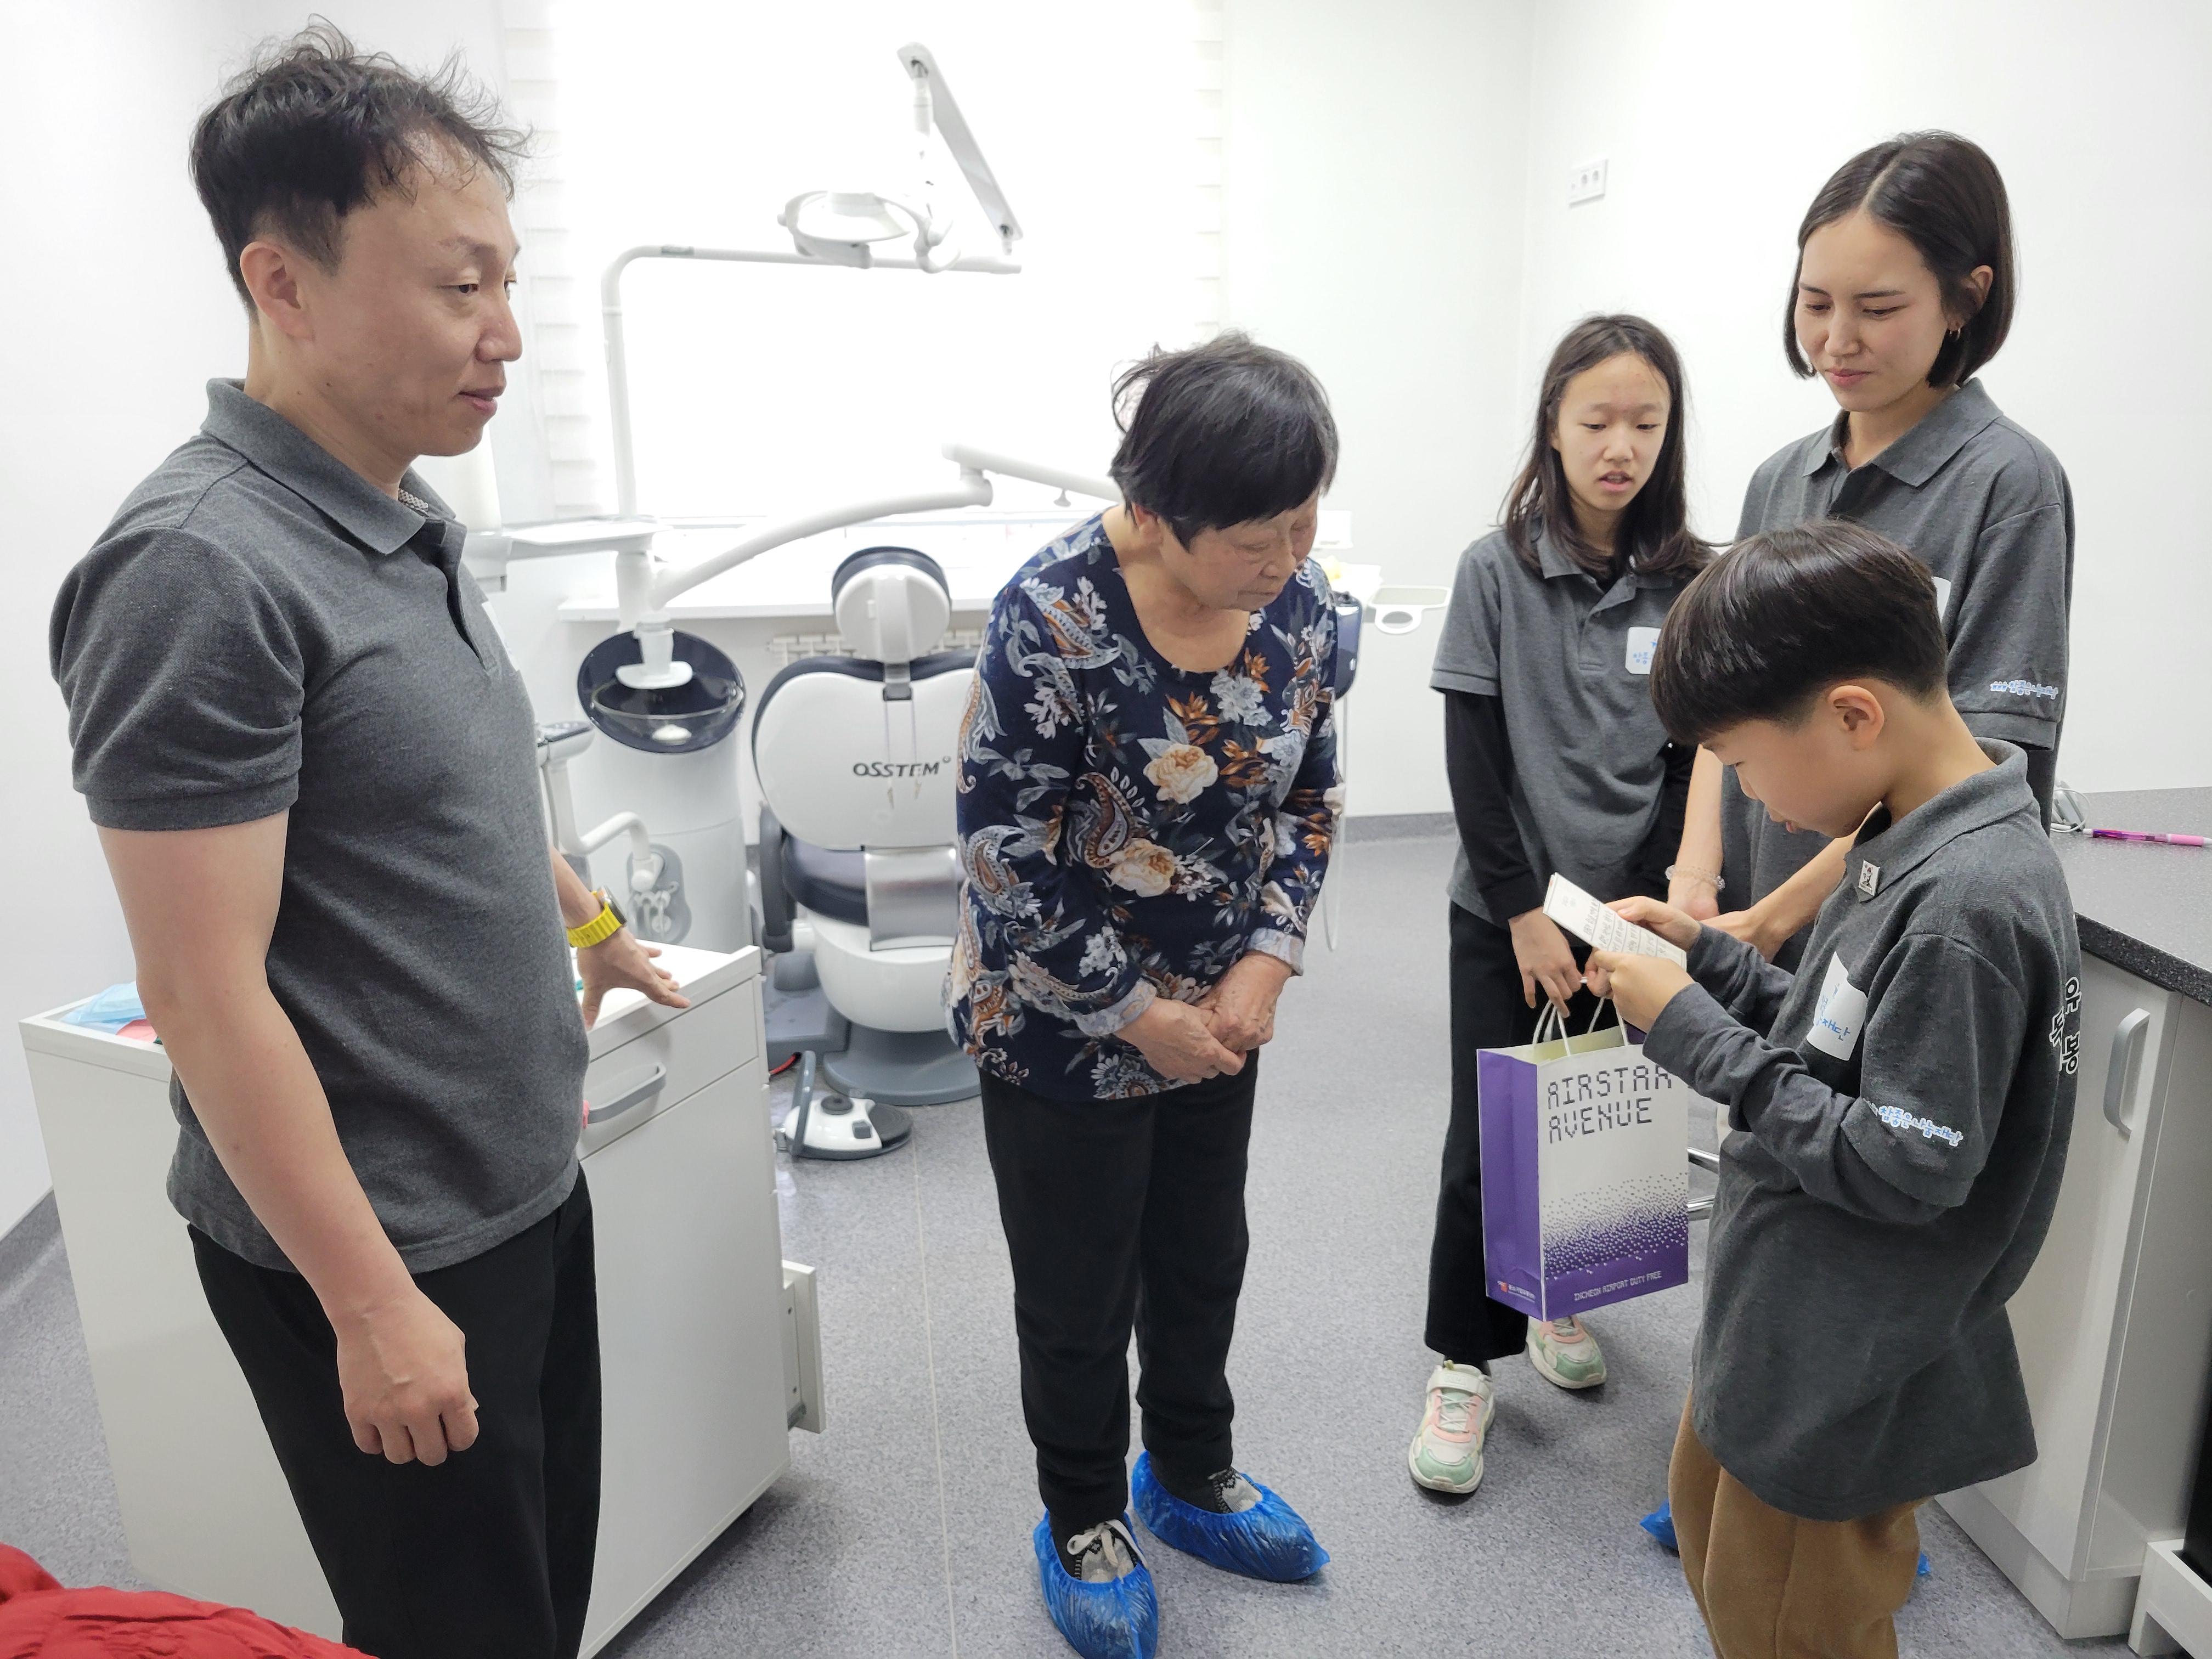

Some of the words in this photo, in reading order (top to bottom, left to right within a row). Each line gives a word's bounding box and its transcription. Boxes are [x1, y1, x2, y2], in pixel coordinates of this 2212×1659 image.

[1548, 1064, 1672, 1110] AIRSTAR
[1549, 1097, 1652, 1144] AVENUE
[1602, 1279, 1628, 1293] AIRPORT
[1646, 1271, 1662, 1282] FREE
